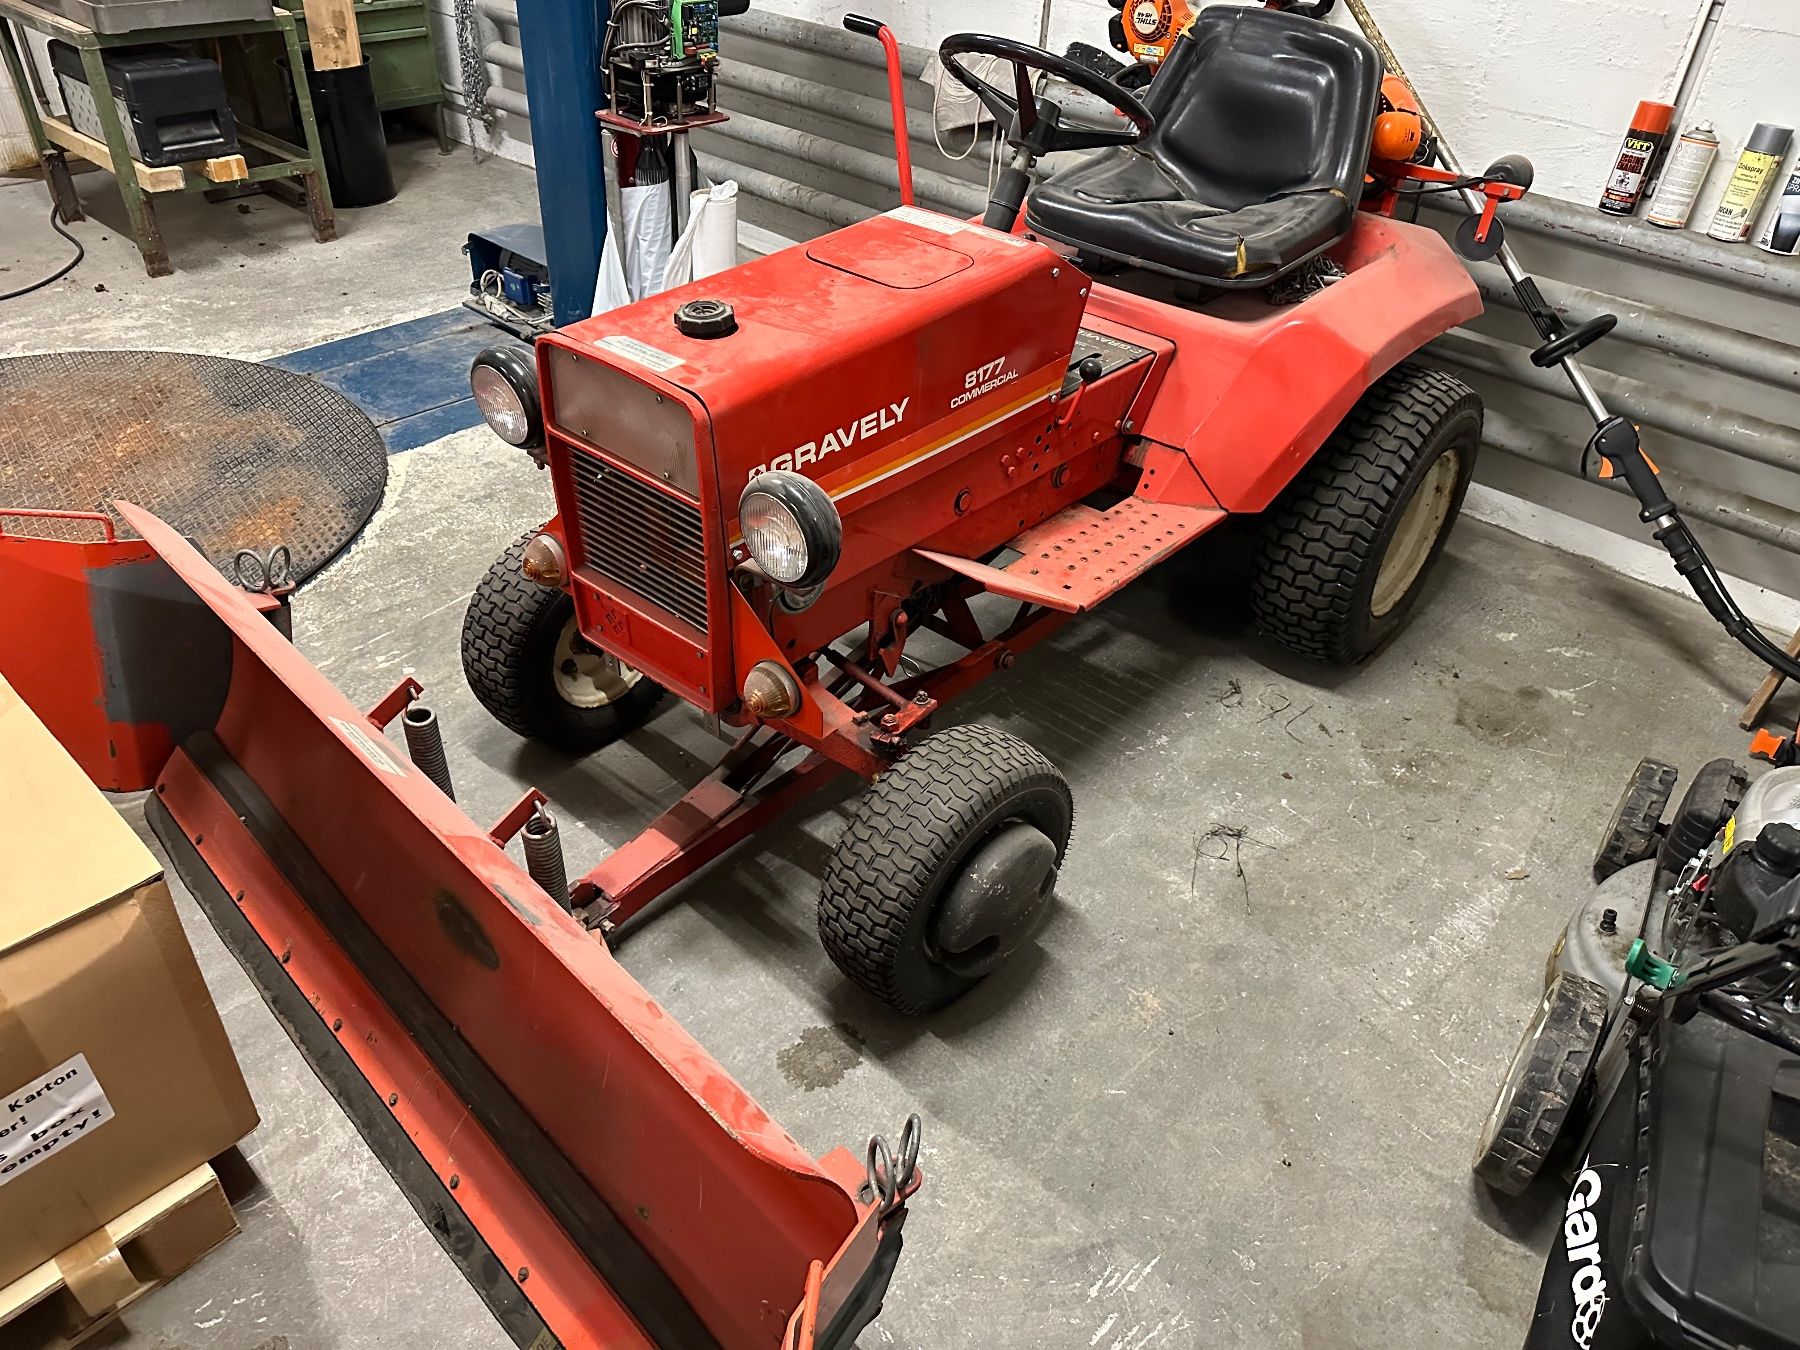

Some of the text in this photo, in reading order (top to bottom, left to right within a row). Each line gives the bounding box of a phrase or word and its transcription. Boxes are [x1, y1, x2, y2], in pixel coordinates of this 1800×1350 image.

[1135, 17, 1157, 26] STIHL
[1627, 138, 1651, 151] VHT
[950, 368, 1018, 409] COMMERCIAL
[964, 355, 1006, 390] 8177
[770, 396, 910, 473] GRAVELY
[7, 1067, 78, 1113] Karton
[30, 1106, 85, 1142] box
